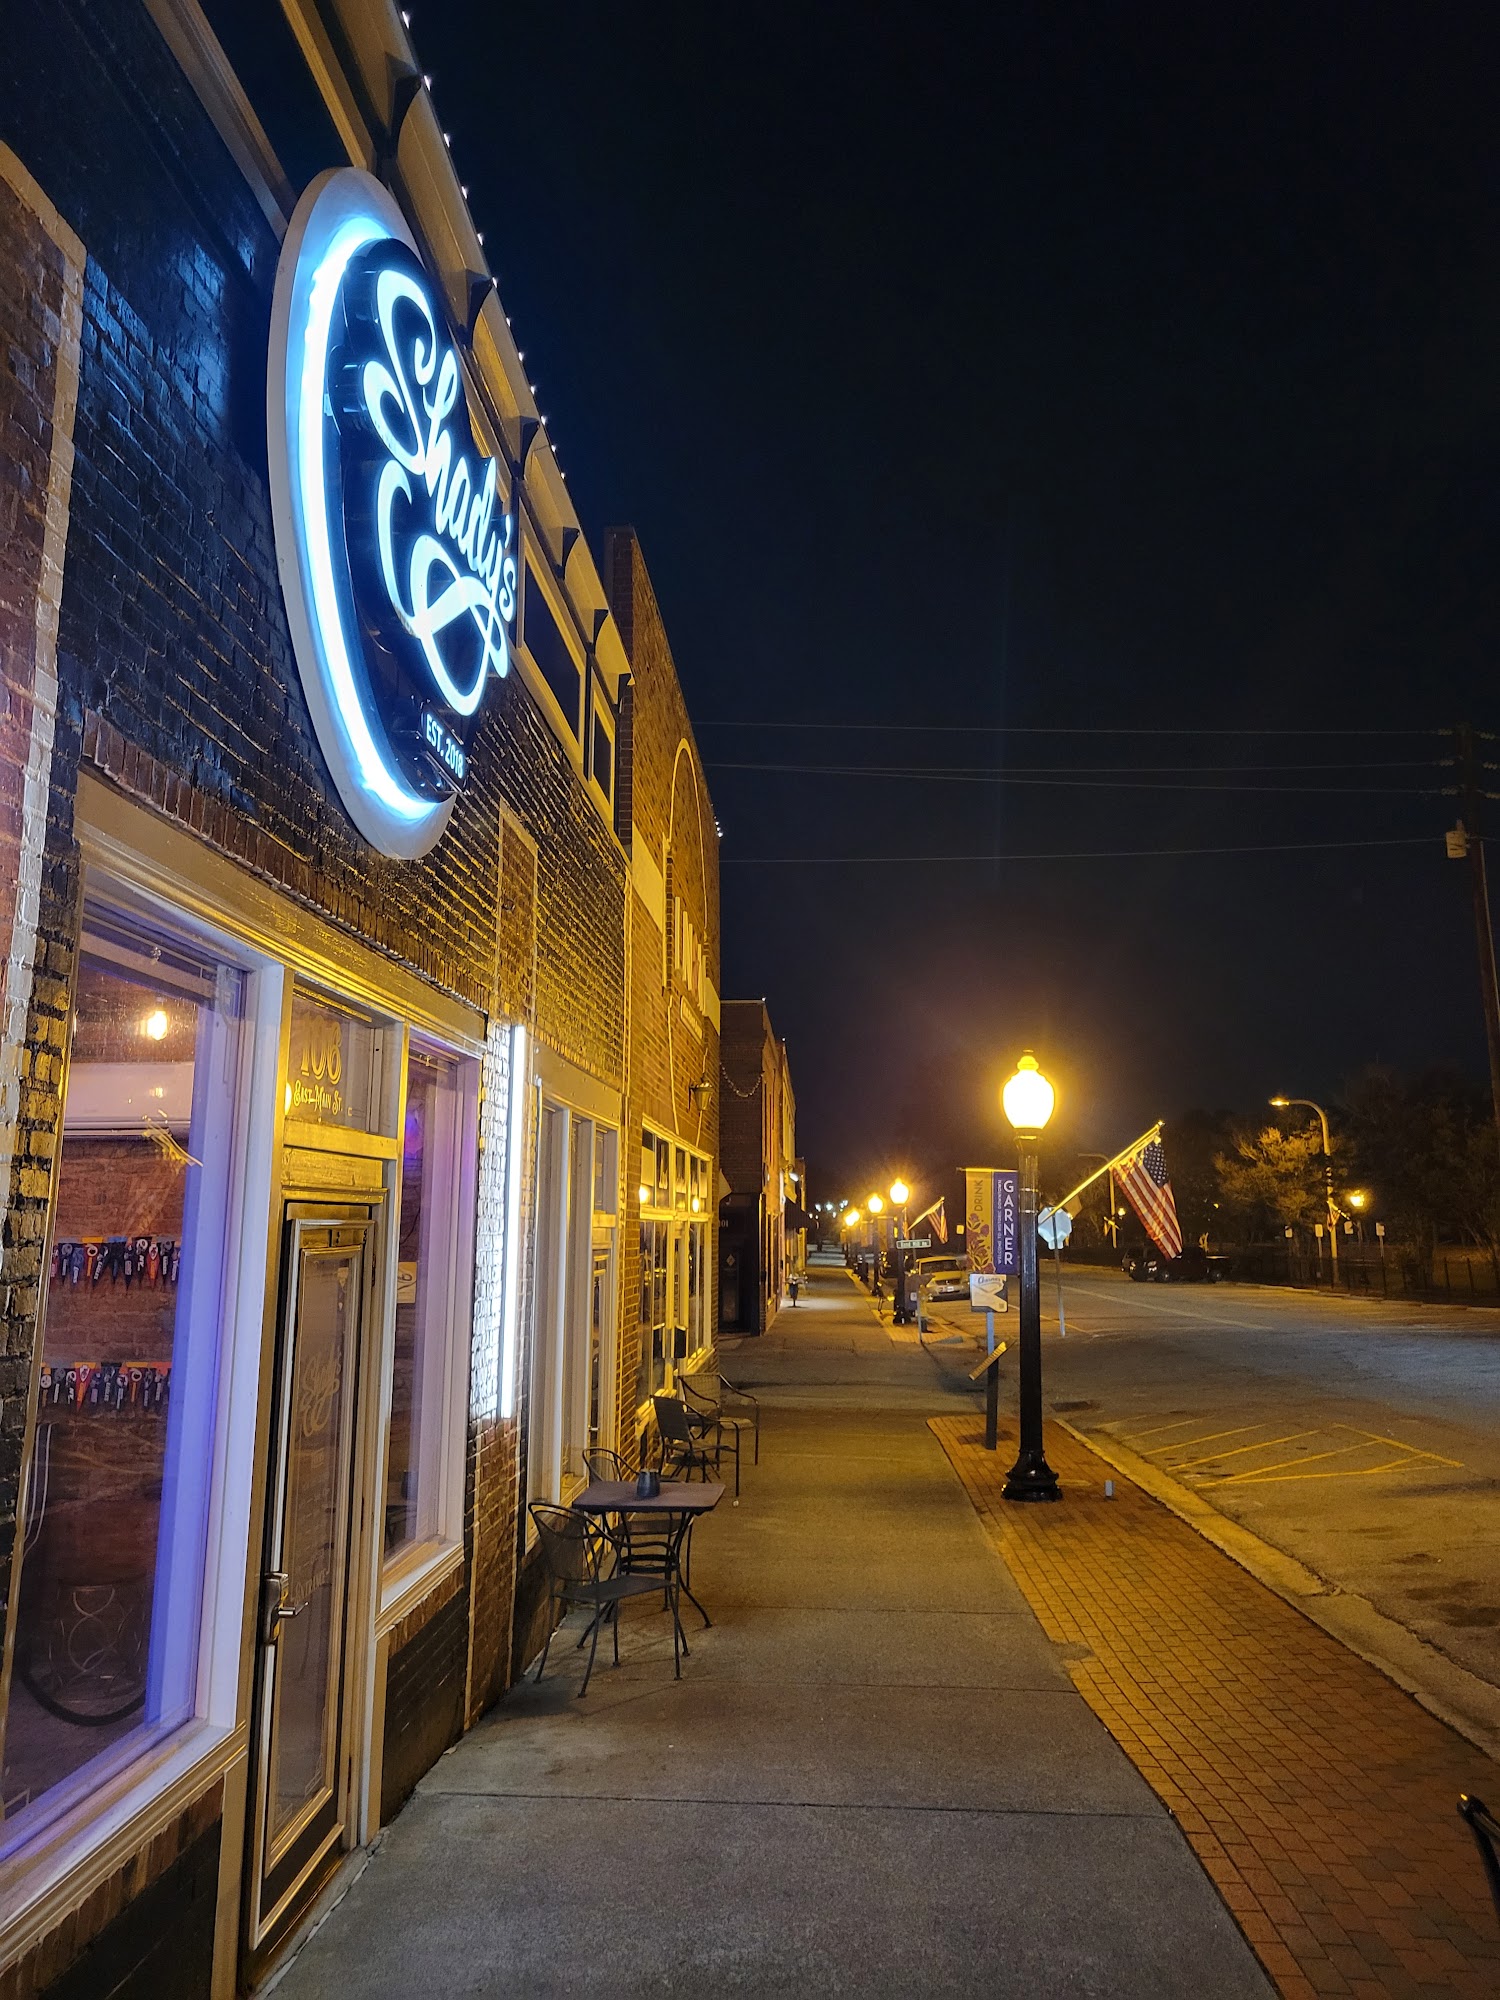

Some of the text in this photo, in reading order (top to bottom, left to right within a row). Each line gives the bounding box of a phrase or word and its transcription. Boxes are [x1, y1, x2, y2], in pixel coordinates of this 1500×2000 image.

[362, 268, 516, 717] Shady's
[426, 713, 464, 779] EST. 2018
[973, 1179, 984, 1212] DRINK
[1003, 1179, 1015, 1265] GARNER
